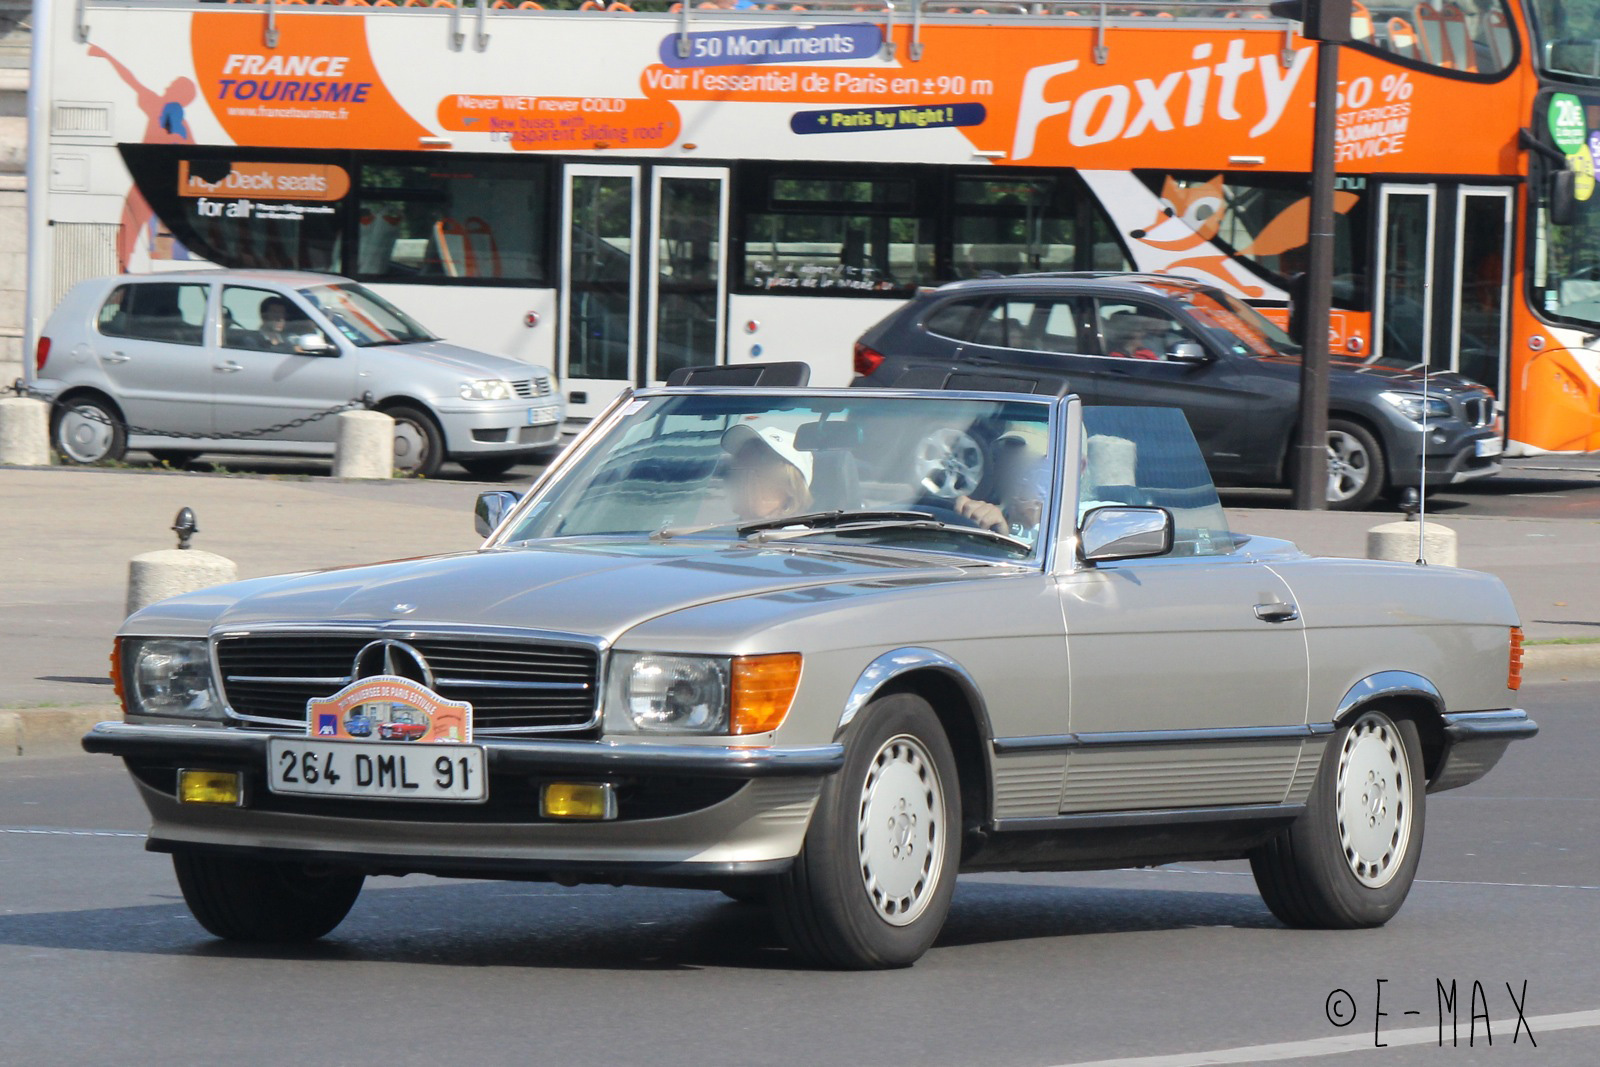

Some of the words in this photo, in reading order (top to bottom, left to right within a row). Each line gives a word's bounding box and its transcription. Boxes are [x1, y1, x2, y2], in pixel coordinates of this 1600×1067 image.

[694, 37, 722, 57] 50
[727, 34, 854, 55] Monuments
[222, 54, 350, 77] FRANCE
[218, 80, 372, 102] TOURISME
[646, 69, 688, 90] Voir
[692, 70, 797, 91] l'essentiel
[801, 72, 830, 92] de
[834, 72, 888, 93] Paris
[891, 77, 918, 93] en
[971, 79, 993, 95] m
[1381, 72, 1414, 102] %
[457, 96, 499, 109] Never
[502, 96, 537, 110] WET
[538, 99, 579, 111] never
[581, 98, 627, 112] COLD
[1011, 39, 1314, 161] Foxity
[489, 117, 514, 129] New
[519, 117, 555, 129] buses
[560, 117, 585, 127] with
[831, 111, 873, 126] Paris
[875, 110, 896, 127] by
[899, 109, 944, 126] Night
[490, 129, 575, 143] transparent
[582, 124, 628, 143] sliding
[1335, 117, 1409, 143] AXIMUM
[1334, 134, 1406, 163] ERVICE
[225, 170, 274, 189] Deck
[277, 174, 327, 191] seats
[198, 198, 224, 216] for
[382, 686, 390, 696] DE
[391, 687, 409, 699] PARIS
[409, 692, 437, 715] ESTIVALE
[281, 750, 340, 785] 264
[355, 754, 419, 789] DML
[435, 756, 470, 790] 91
